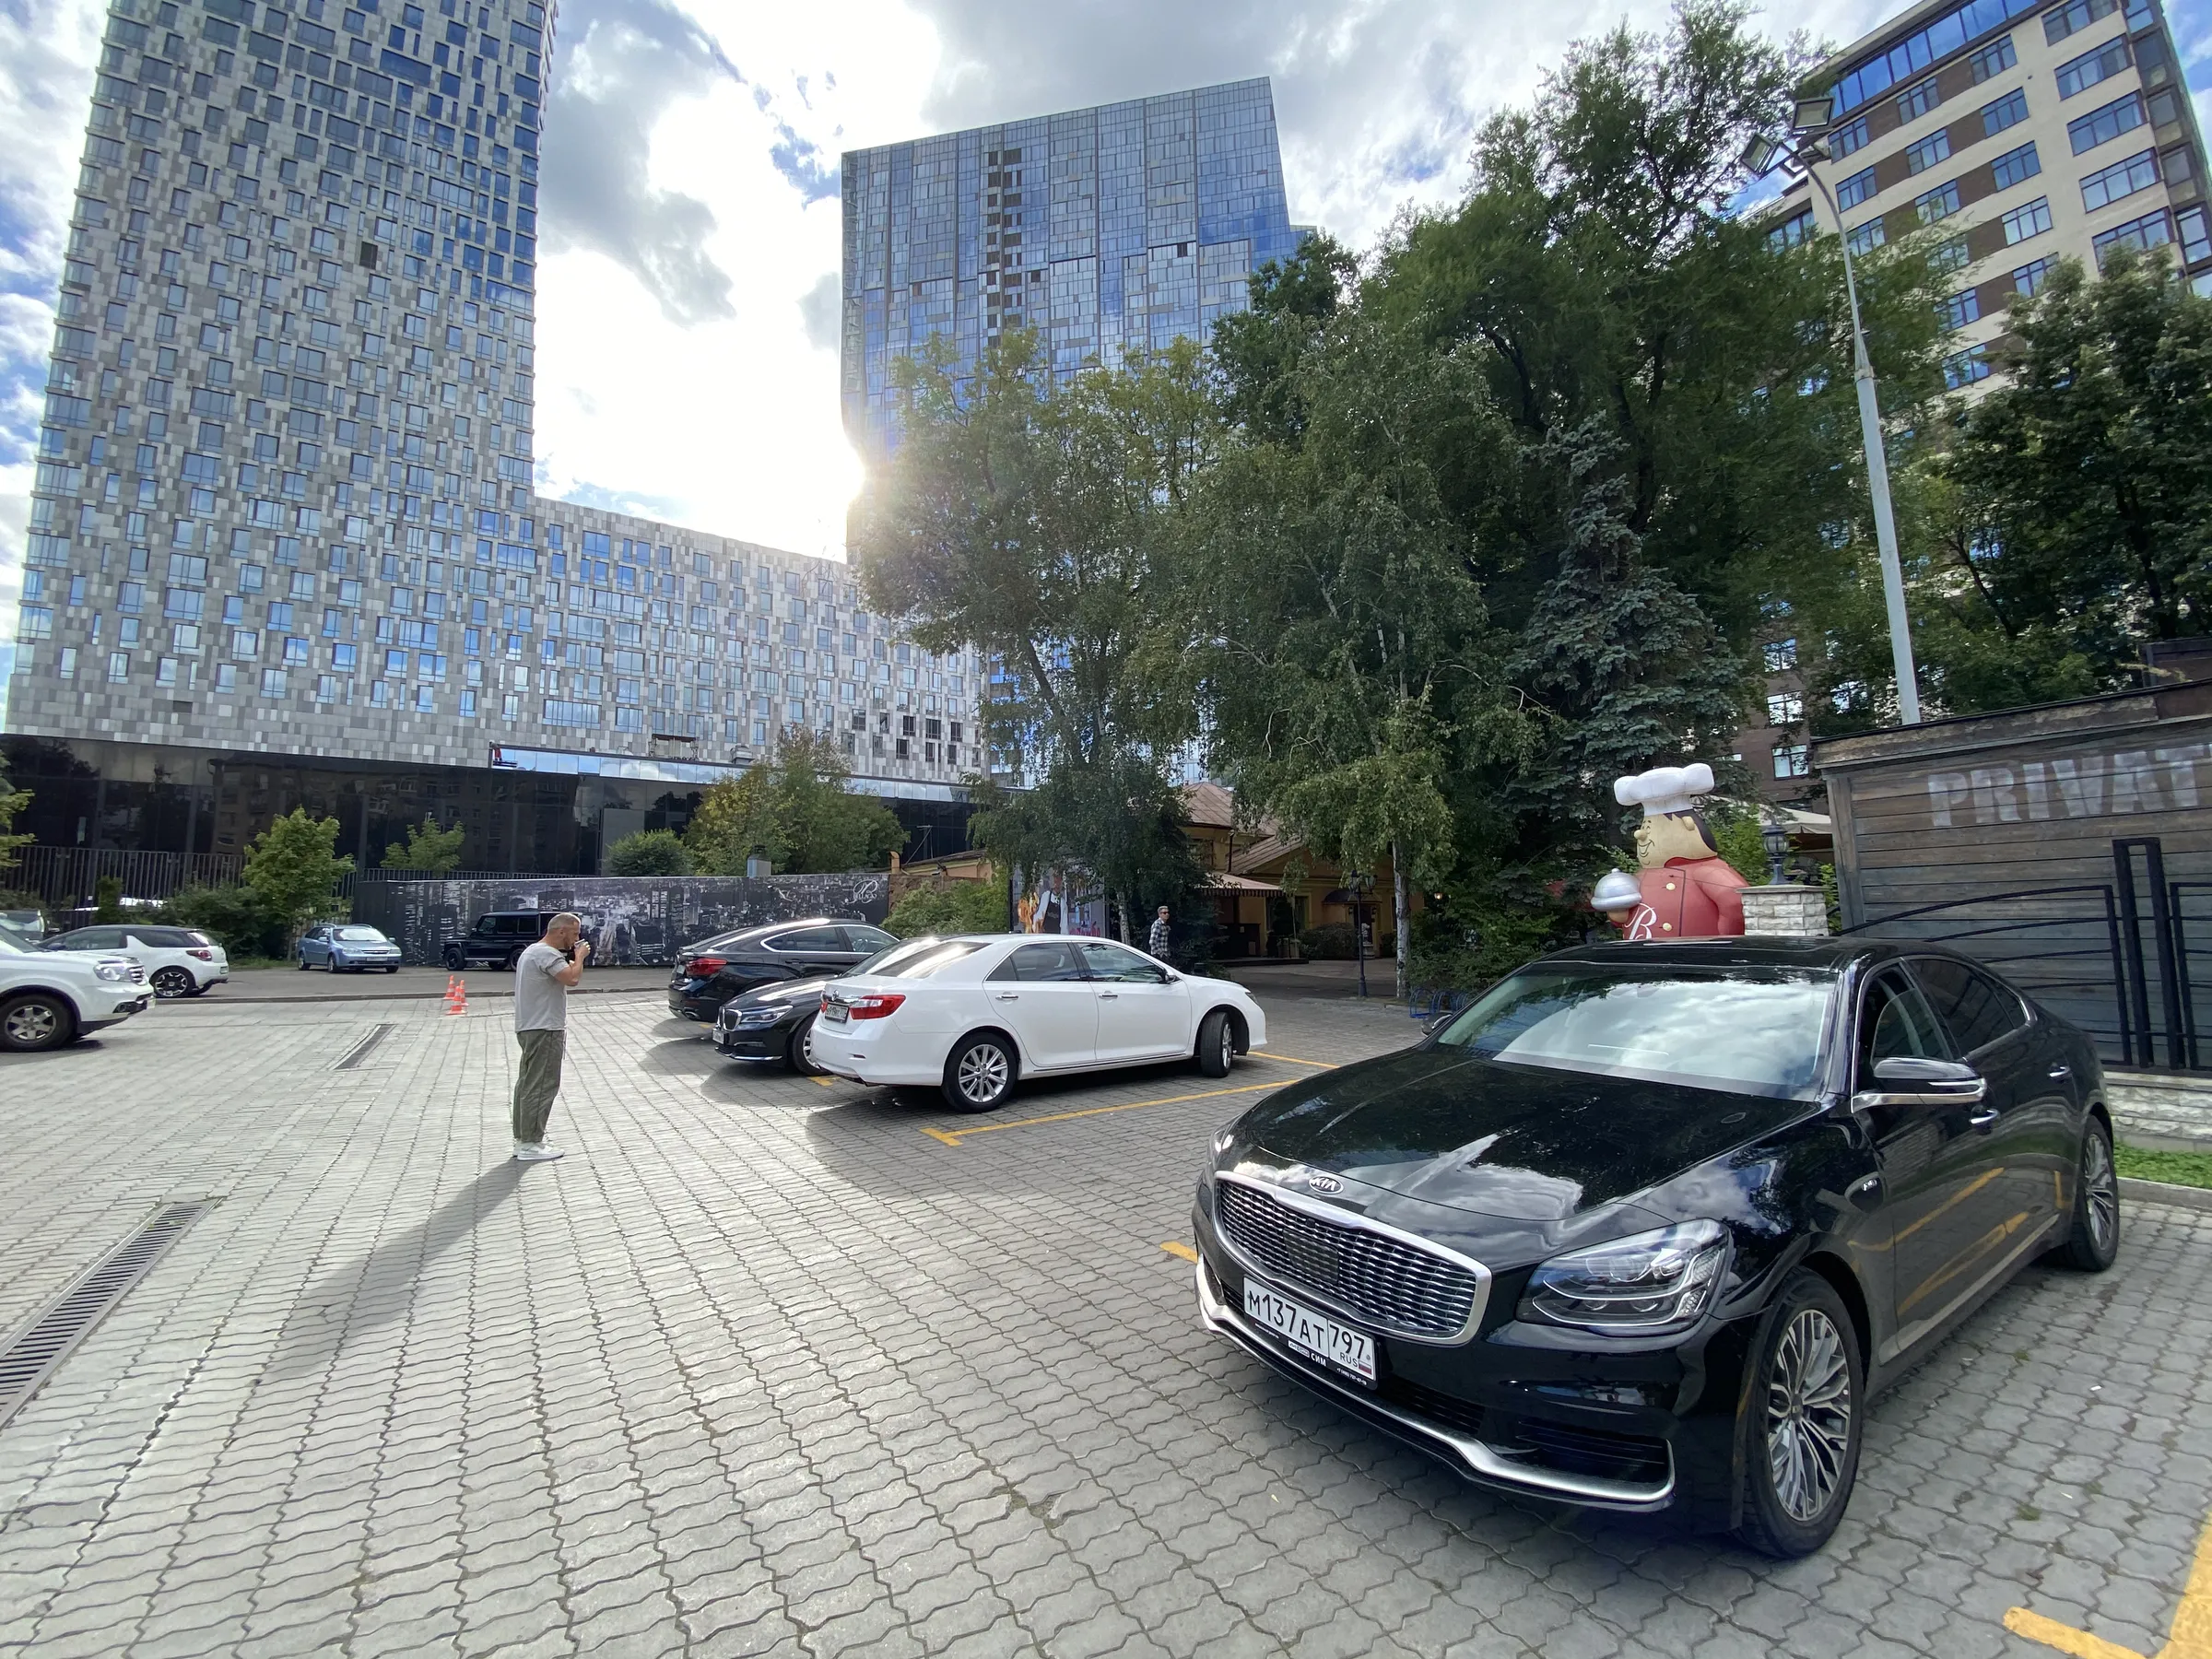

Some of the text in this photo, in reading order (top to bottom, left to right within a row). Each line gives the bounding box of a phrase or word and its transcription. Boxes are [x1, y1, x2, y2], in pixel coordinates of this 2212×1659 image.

[1927, 743, 2212, 827] PRIVAT
[1310, 1177, 1337, 1192] KIA
[1311, 1352, 1327, 1367] СИМ
[1339, 1352, 1359, 1368] RUS
